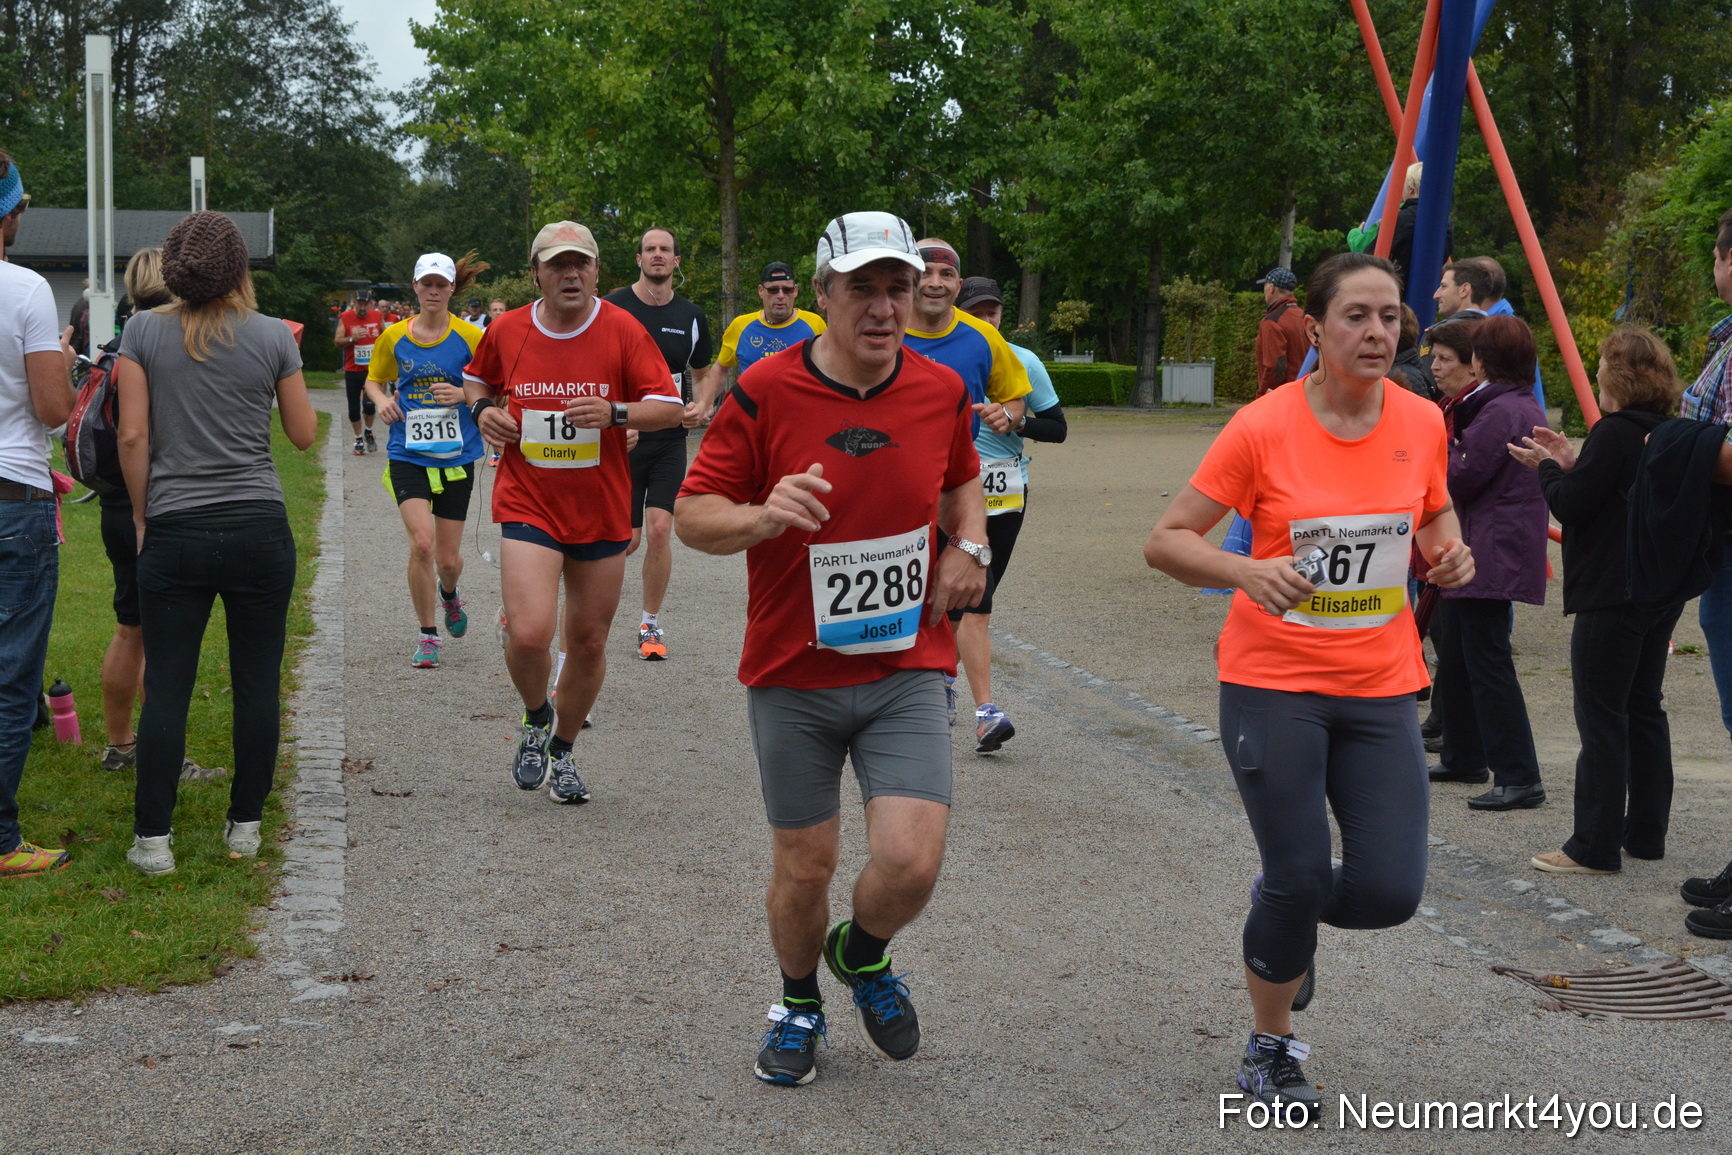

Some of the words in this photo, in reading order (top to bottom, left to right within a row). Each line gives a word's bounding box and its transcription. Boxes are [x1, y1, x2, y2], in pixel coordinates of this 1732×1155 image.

[515, 383, 596, 396] NEUMARKT
[412, 421, 456, 441] 3316
[544, 414, 576, 440] 18
[543, 447, 576, 460] Charly
[983, 471, 1006, 493] 43
[1293, 528, 1335, 540] PARTL
[1339, 525, 1393, 539] Neumarkt
[813, 553, 857, 567] PARTL
[860, 544, 915, 563] Neumarkt
[1328, 543, 1376, 586] 67
[827, 559, 923, 616] 2288
[1311, 596, 1381, 612] Elisabeth
[860, 618, 903, 639] Josef
